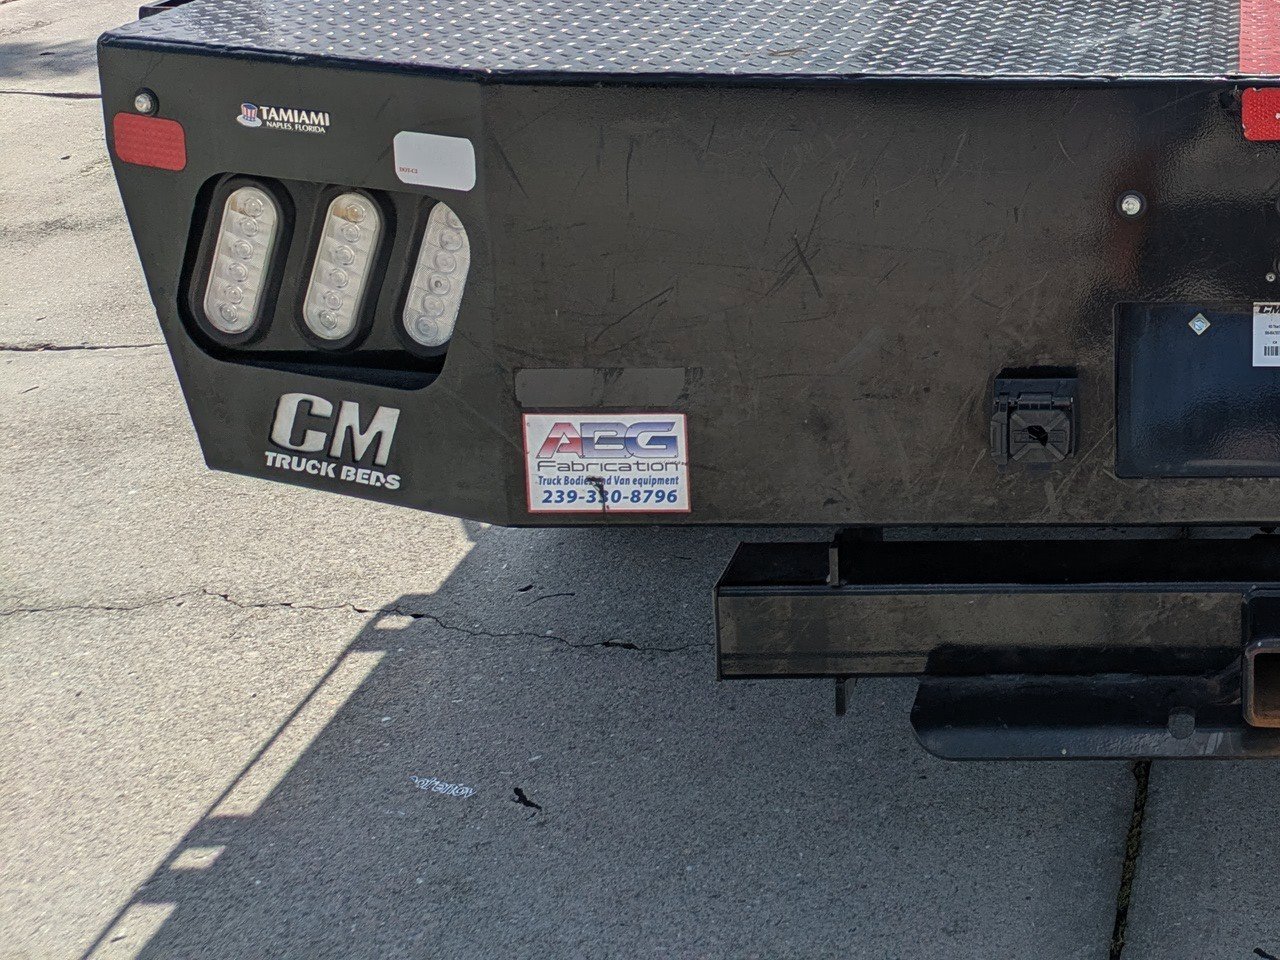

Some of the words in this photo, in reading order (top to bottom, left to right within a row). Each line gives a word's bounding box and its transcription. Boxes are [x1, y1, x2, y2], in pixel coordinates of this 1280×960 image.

[260, 106, 330, 126] TAMIAMI
[266, 121, 294, 131] NAPLES,
[295, 124, 326, 133] FLORIDA
[269, 392, 400, 467] CM
[264, 451, 337, 478] TRUCK
[340, 466, 401, 489] BEDS
[537, 460, 679, 472] Fabrication
[539, 475, 561, 485] Truck
[614, 476, 630, 485] Van
[632, 475, 679, 487] equipment
[542, 489, 678, 503] 239-330-8796
